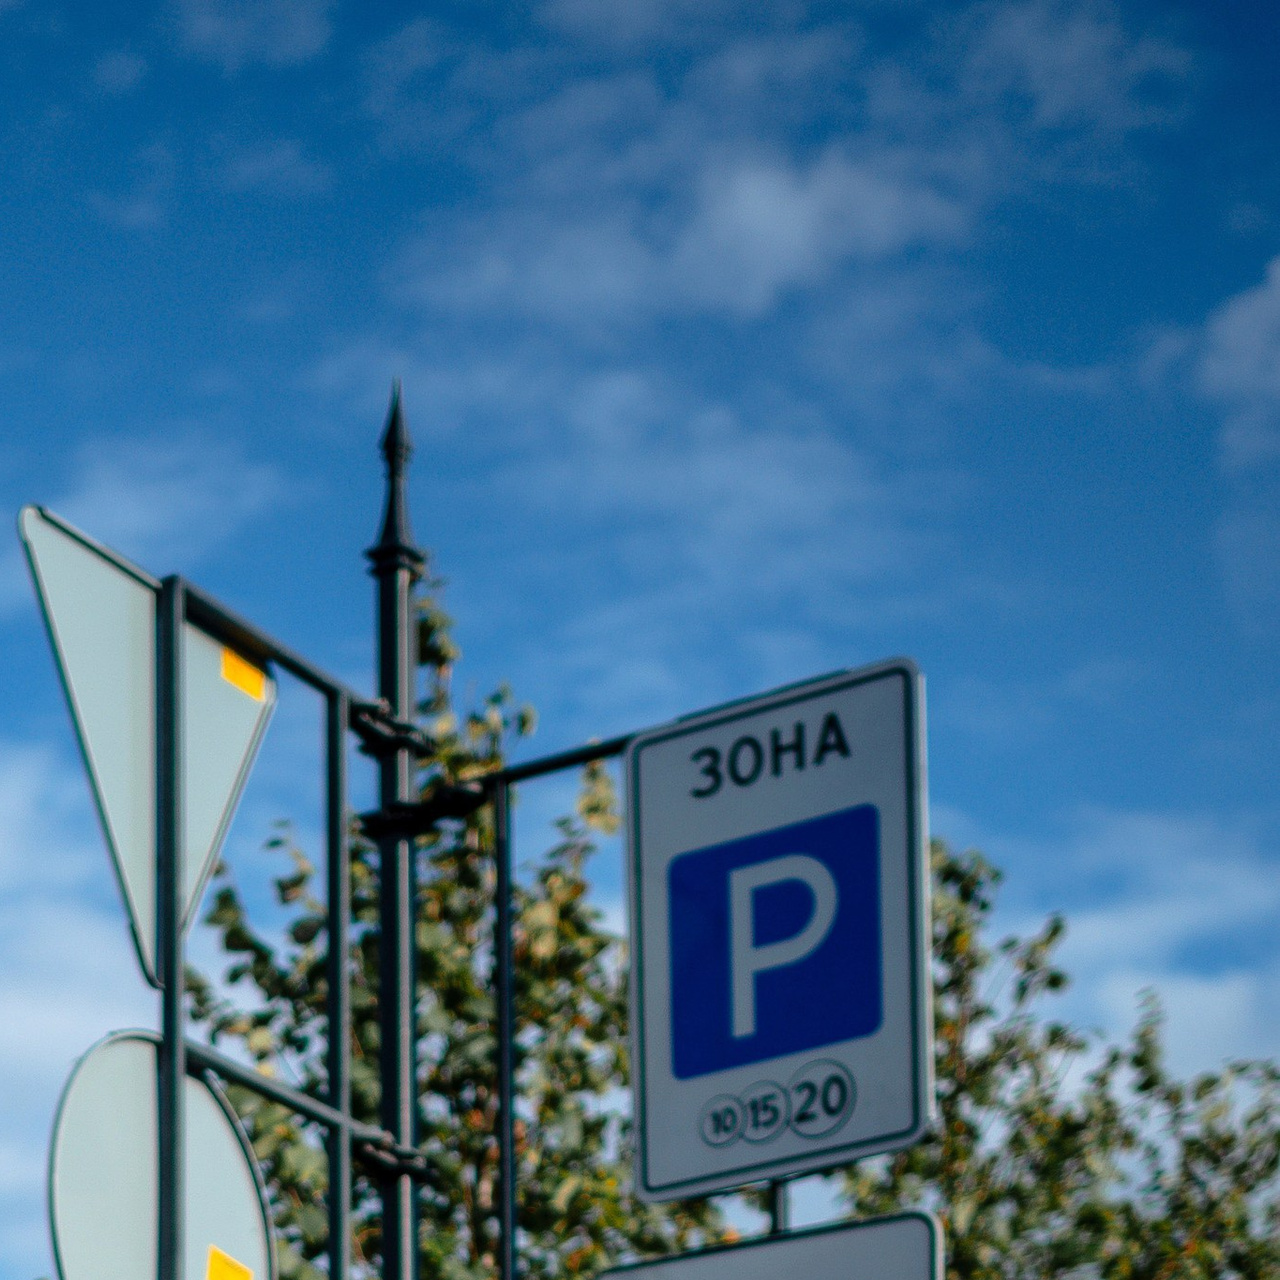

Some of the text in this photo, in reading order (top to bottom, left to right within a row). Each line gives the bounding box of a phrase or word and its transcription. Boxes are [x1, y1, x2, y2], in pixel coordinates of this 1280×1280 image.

[690, 711, 851, 798] ЗОНА
[730, 854, 839, 1039] P
[710, 1073, 848, 1134] 10 15 20
